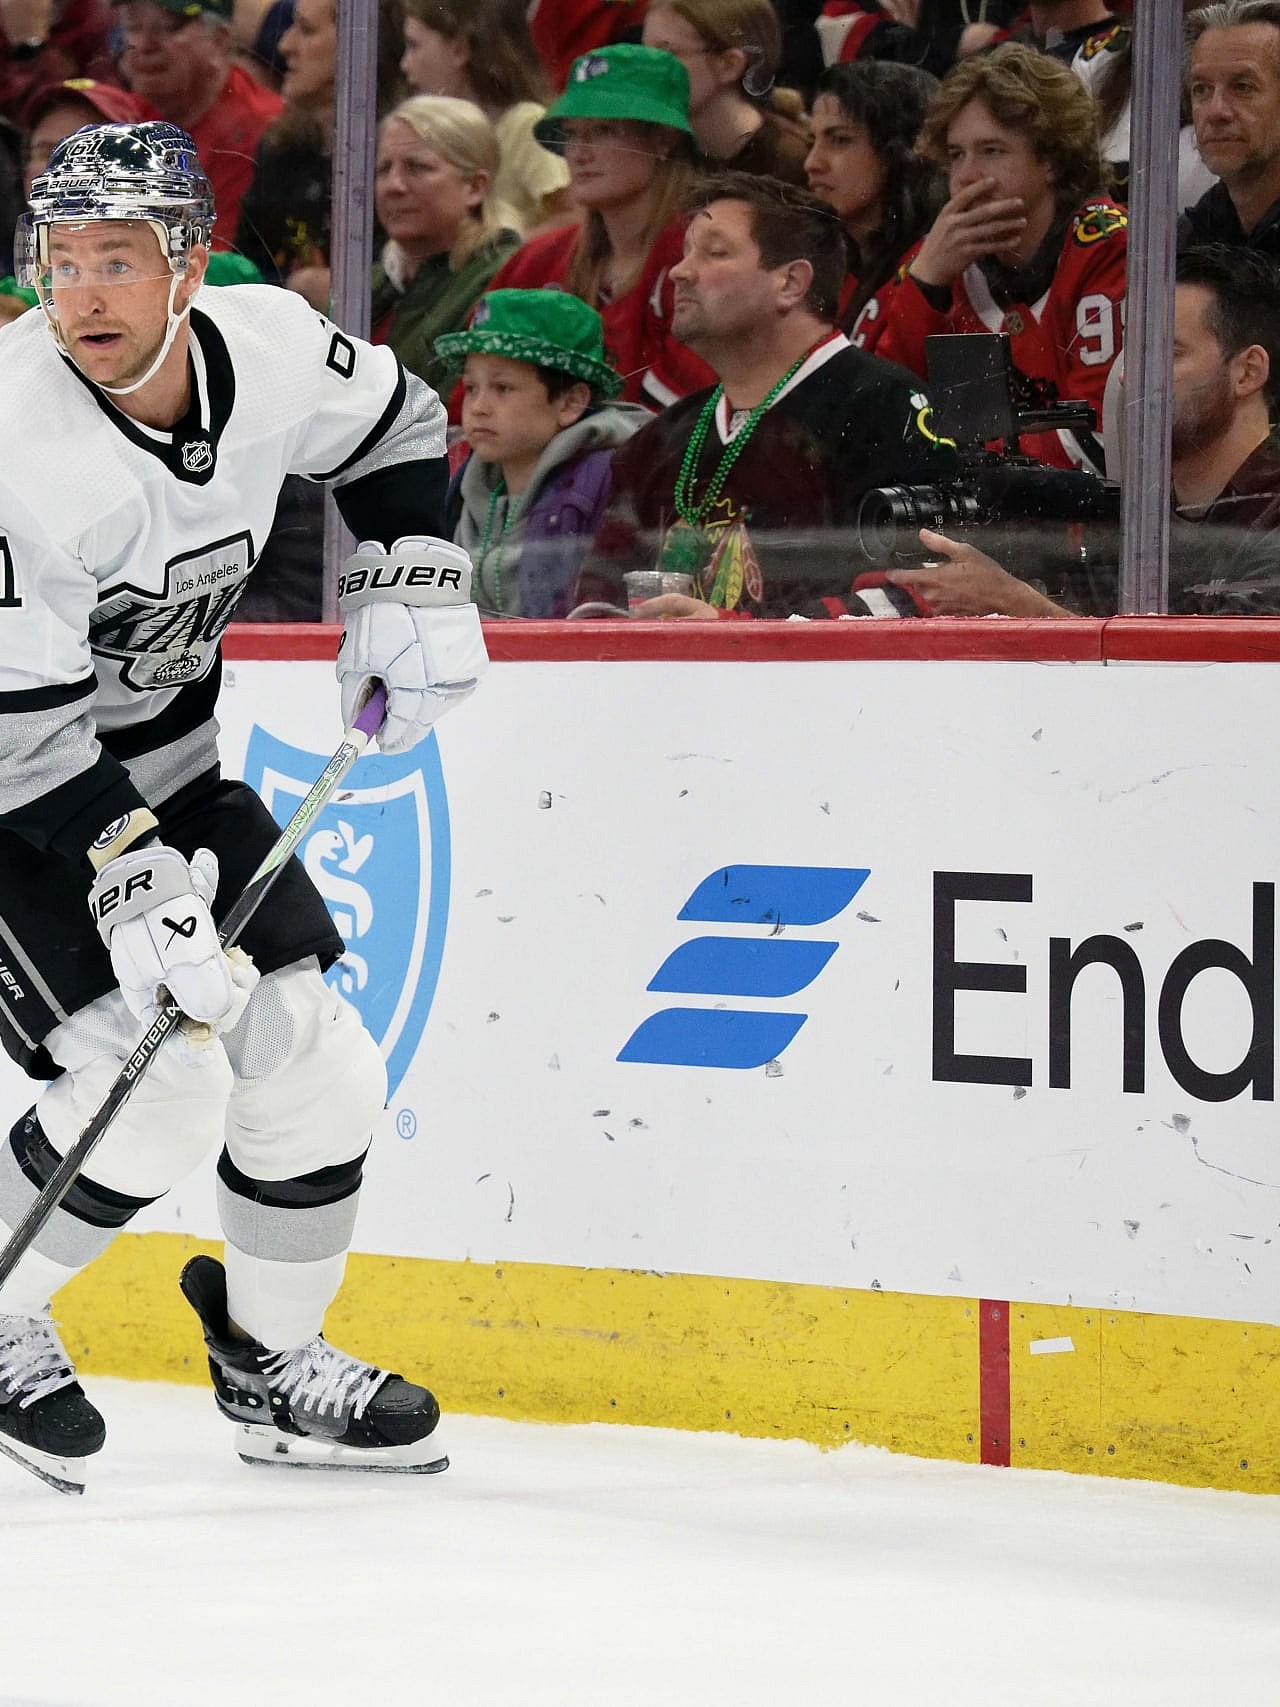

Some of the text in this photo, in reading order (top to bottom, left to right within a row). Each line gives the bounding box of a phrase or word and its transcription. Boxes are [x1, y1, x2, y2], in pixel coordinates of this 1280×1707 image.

[69, 138, 105, 157] 61
[50, 177, 101, 189] BAUER
[1076, 293, 1129, 367] 9
[190, 448, 206, 466] NHL
[933, 514, 945, 525] 18
[175, 562, 239, 594] Los Angeles
[337, 566, 462, 599] BAUER
[92, 869, 154, 920] ER
[932, 871, 1275, 1102] End
[122, 1014, 170, 1080] BAUER
